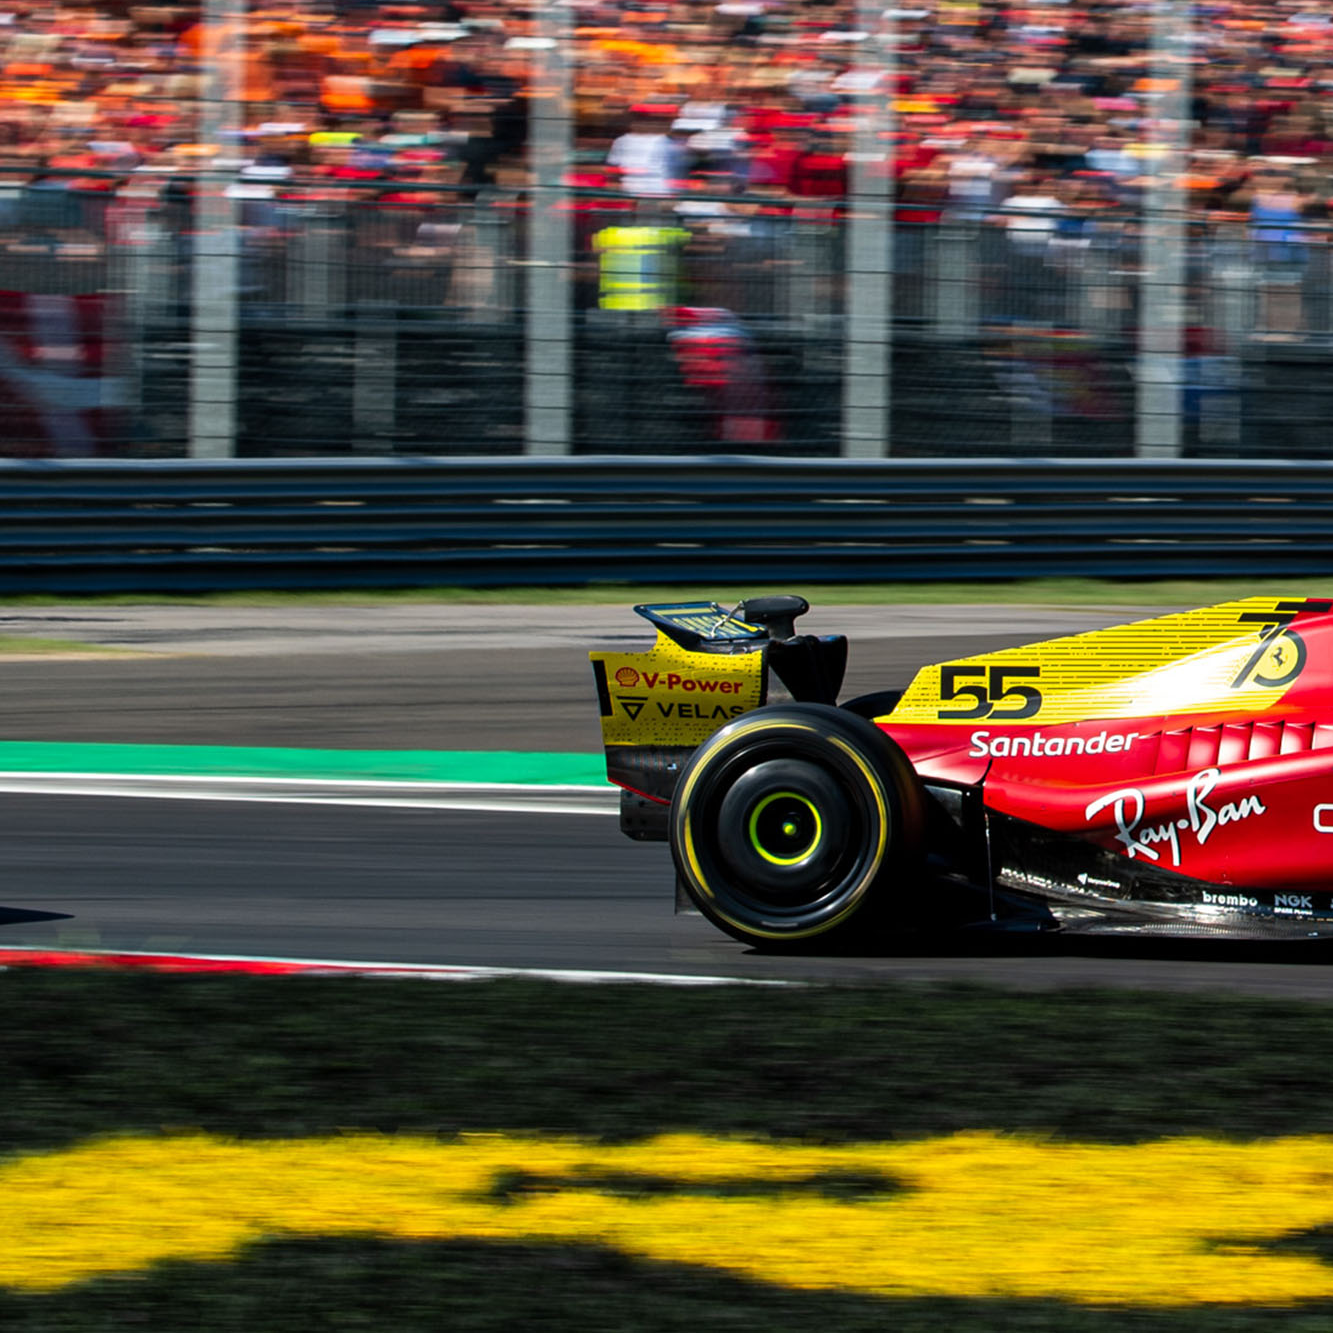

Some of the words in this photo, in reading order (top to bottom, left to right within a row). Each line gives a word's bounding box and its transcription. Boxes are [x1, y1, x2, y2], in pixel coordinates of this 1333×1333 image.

[642, 672, 744, 694] V-Power
[937, 666, 1042, 719] 55
[968, 731, 1139, 758] Santander
[1202, 890, 1258, 907] brembo
[1274, 894, 1313, 908] NGK
